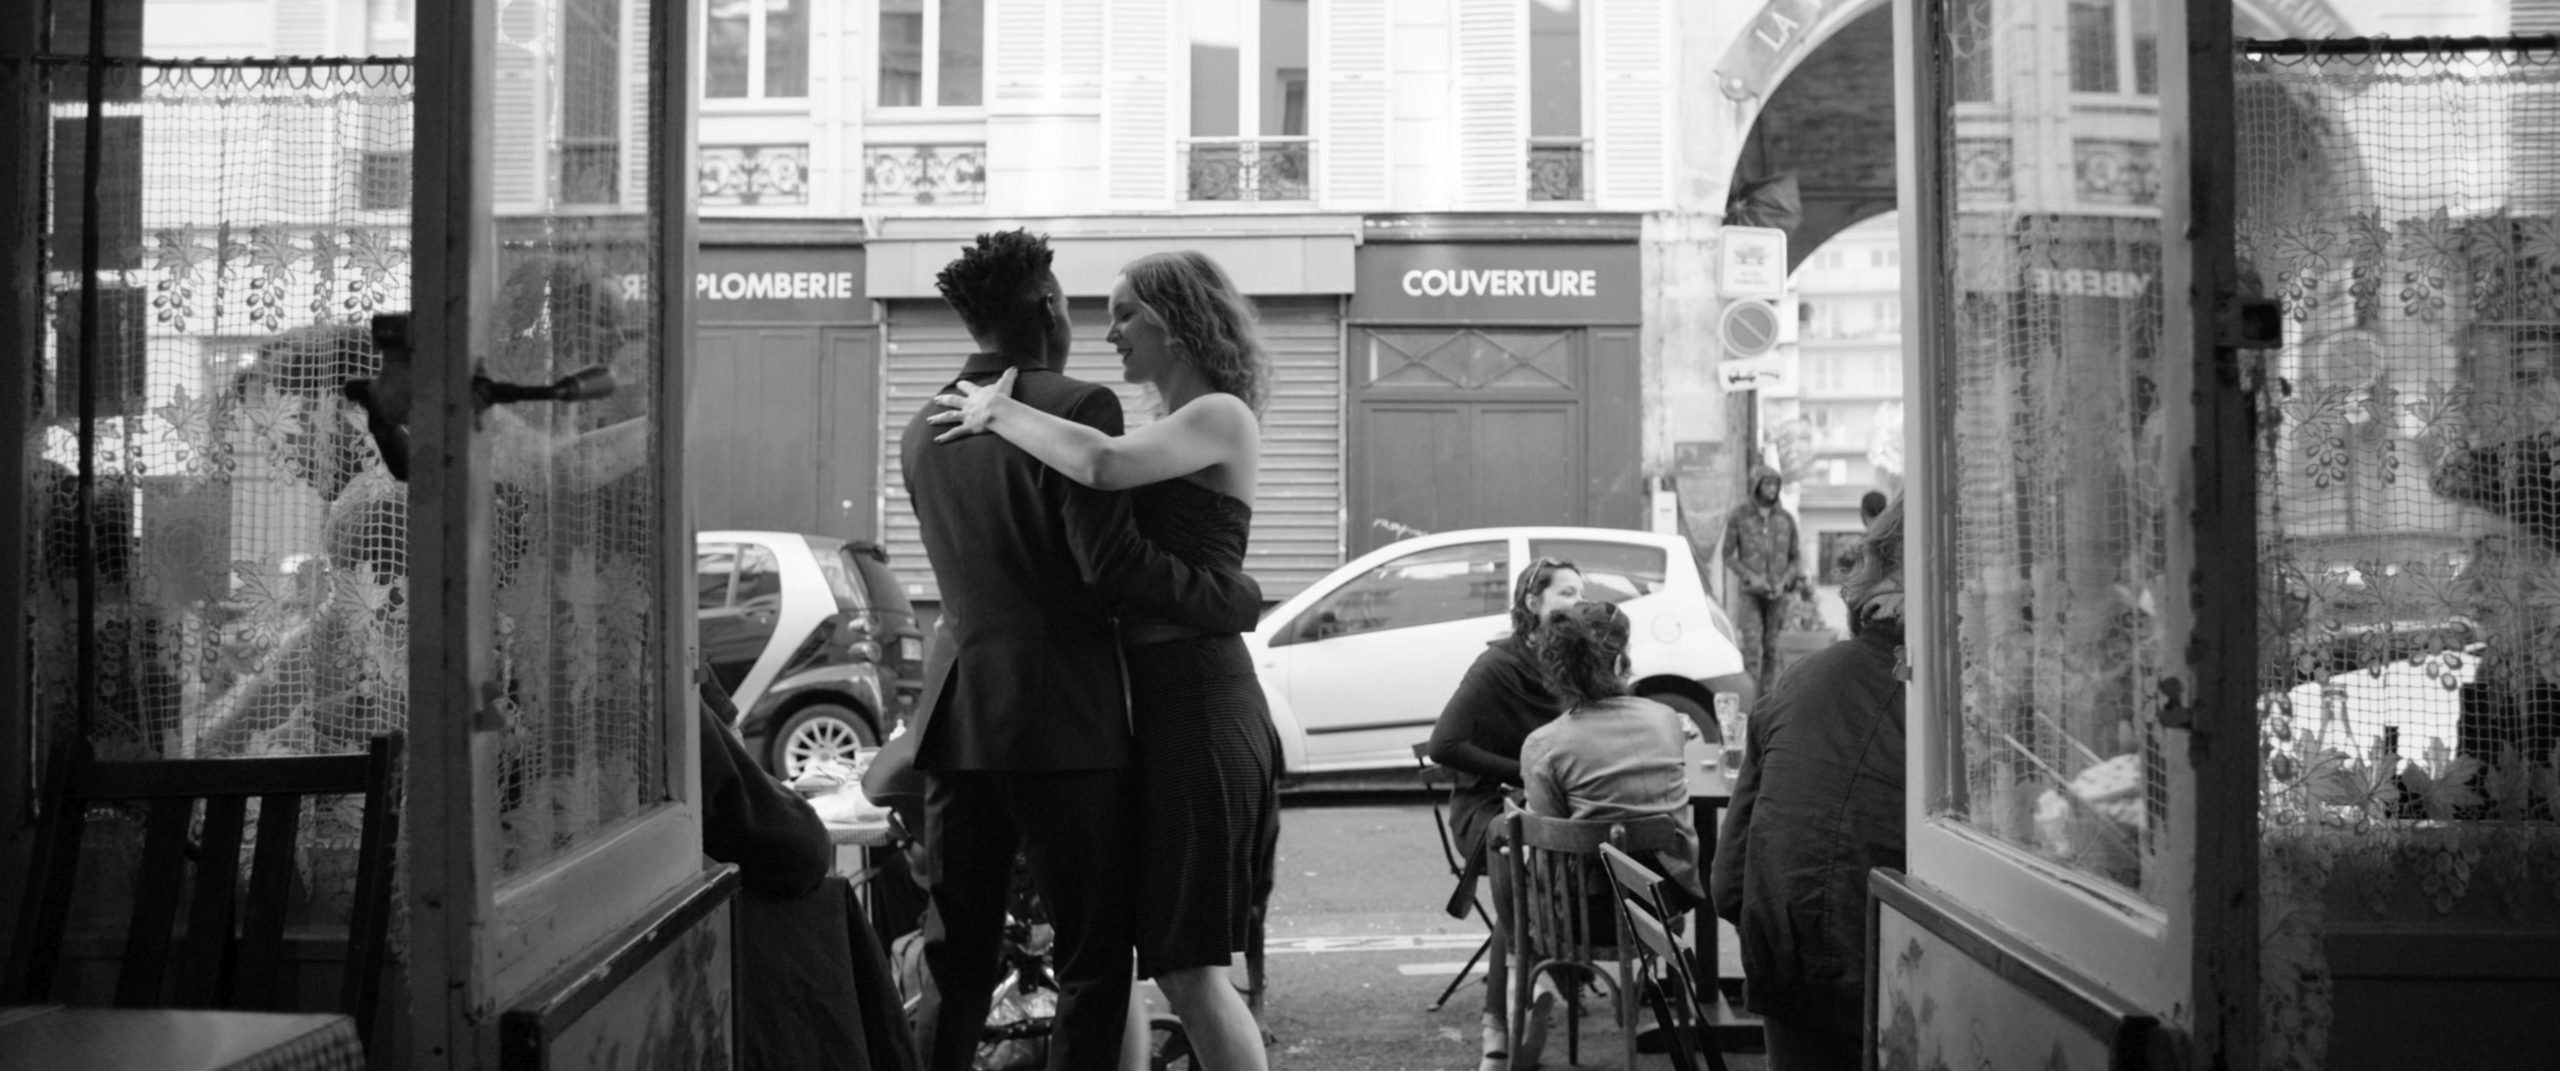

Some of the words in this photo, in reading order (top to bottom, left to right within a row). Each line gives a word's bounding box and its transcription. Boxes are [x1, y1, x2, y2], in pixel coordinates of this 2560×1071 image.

[1755, 11, 1800, 51] LA
[697, 272, 852, 299] PLOMBERIE
[1402, 269, 1597, 297] COUVERTURE
